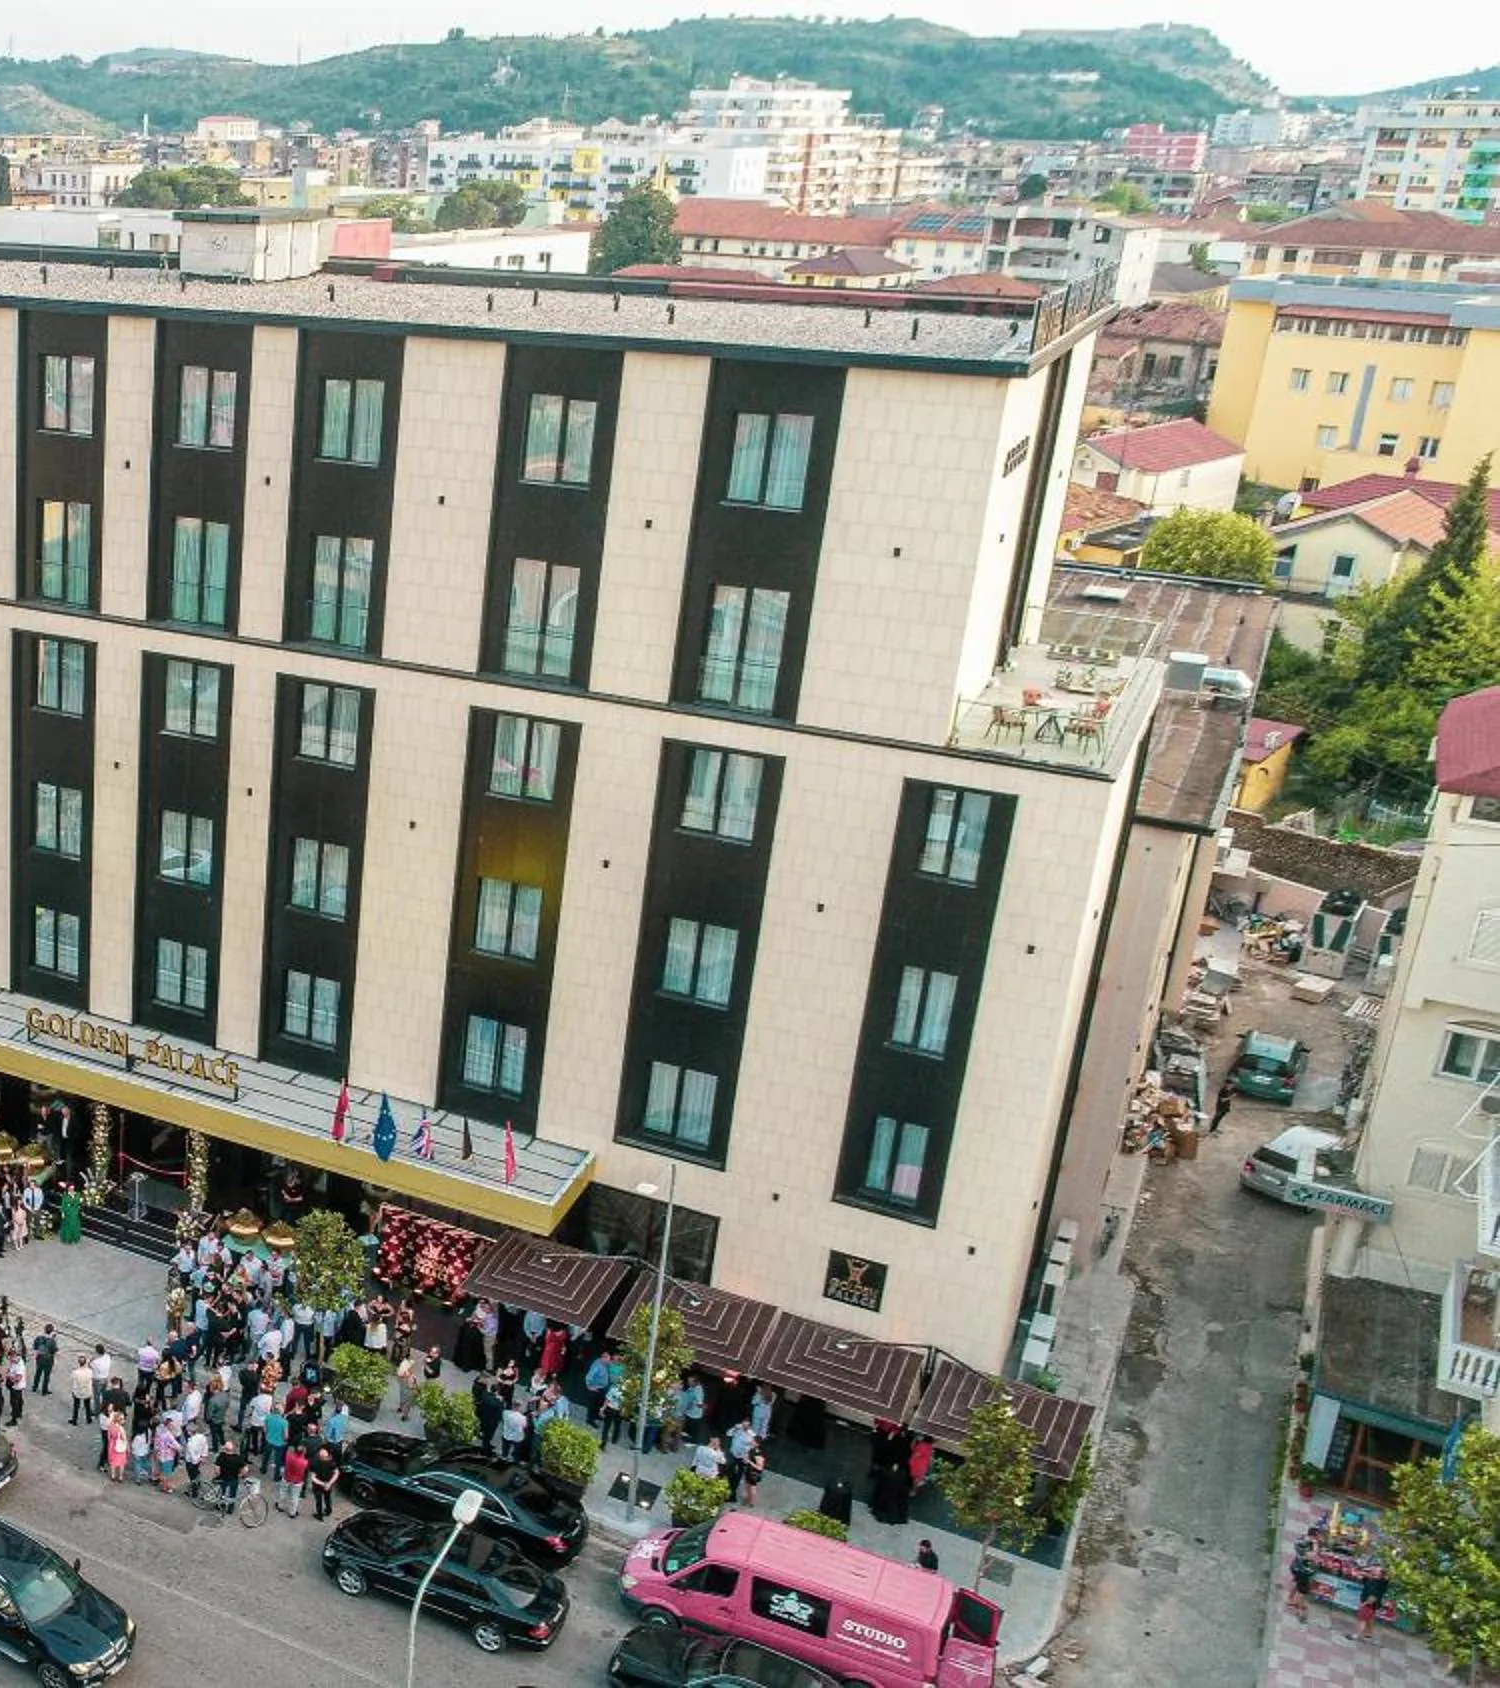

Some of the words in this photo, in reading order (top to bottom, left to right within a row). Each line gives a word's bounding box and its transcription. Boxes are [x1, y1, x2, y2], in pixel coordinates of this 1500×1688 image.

[25, 1007, 129, 1058] GOLDEN
[142, 1039, 240, 1088] PALACE
[841, 1619, 906, 1649] STUDIO
